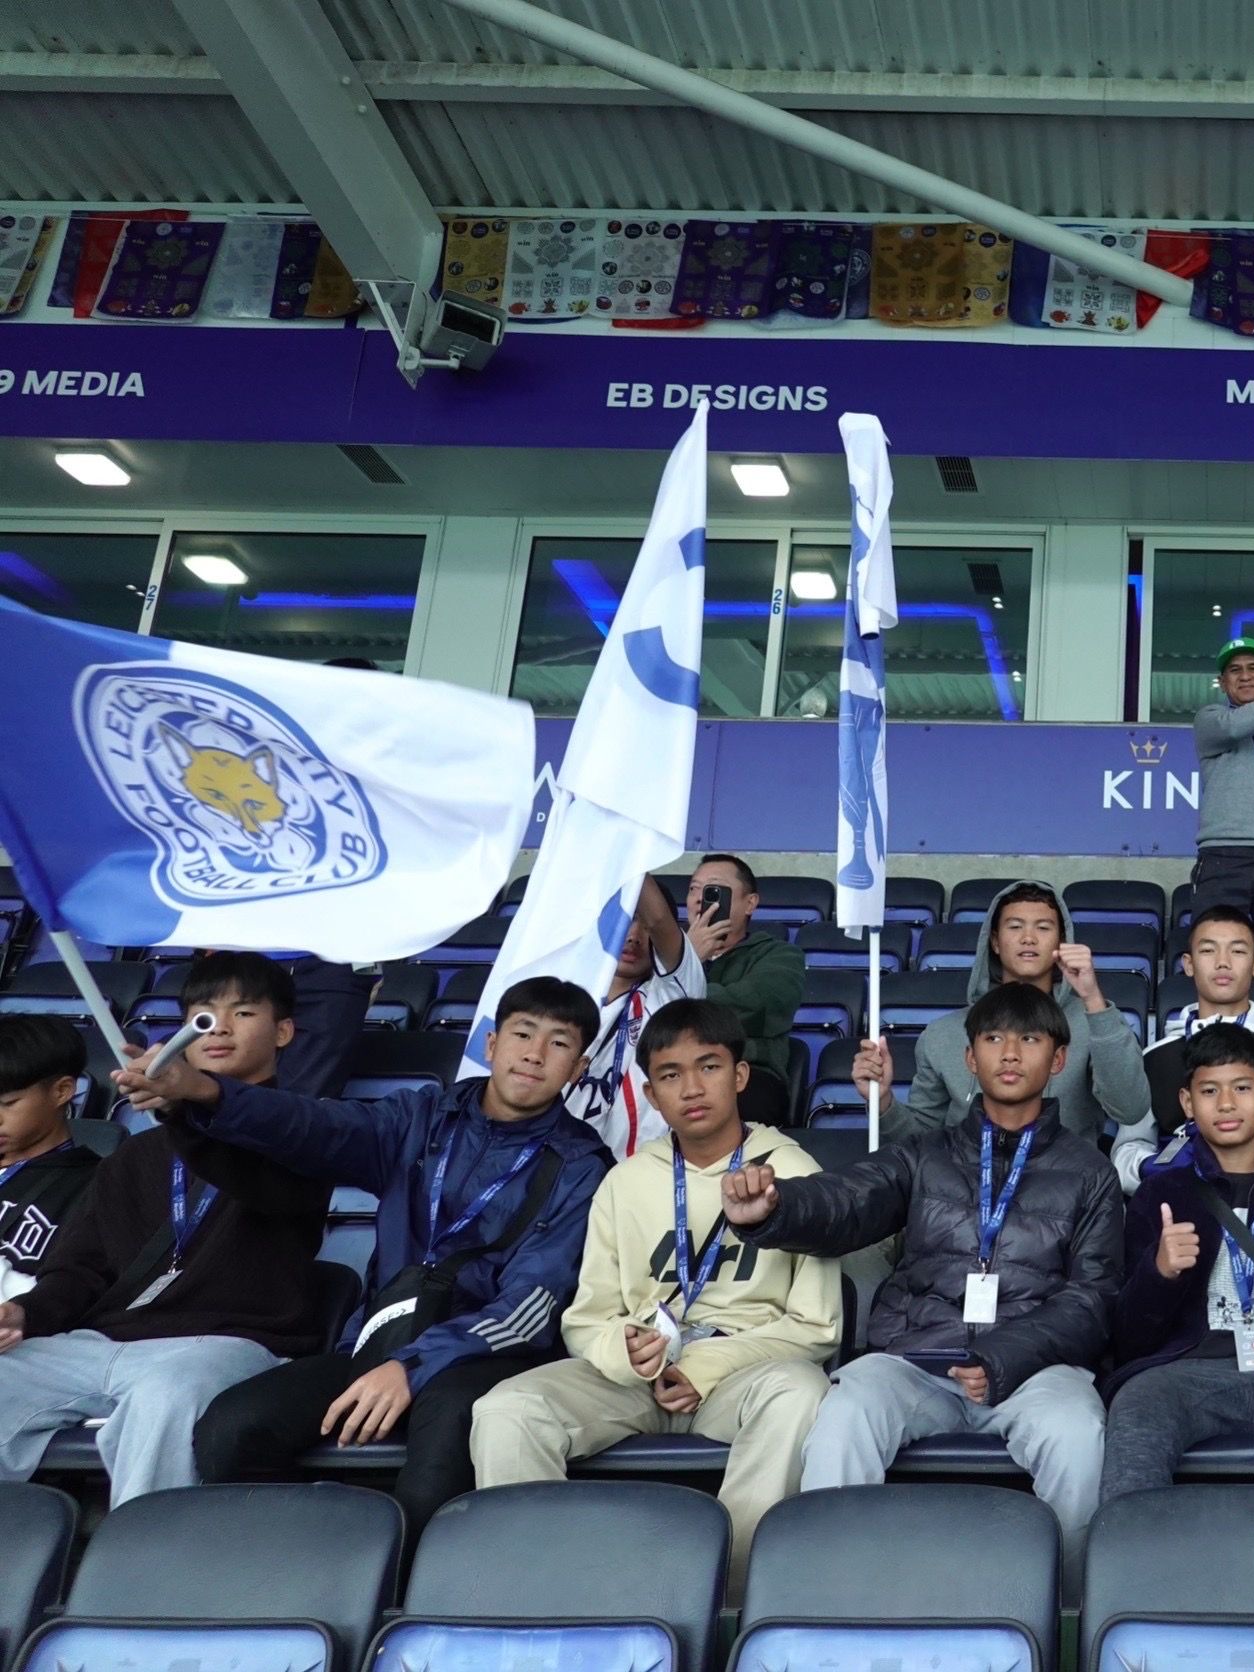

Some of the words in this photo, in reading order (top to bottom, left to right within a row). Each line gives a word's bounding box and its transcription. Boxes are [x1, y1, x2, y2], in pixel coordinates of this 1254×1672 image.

[22, 370, 146, 398] MEDIA
[606, 382, 654, 408] EB
[663, 383, 828, 412] DESIGNS
[1103, 770, 1199, 810] KIN
